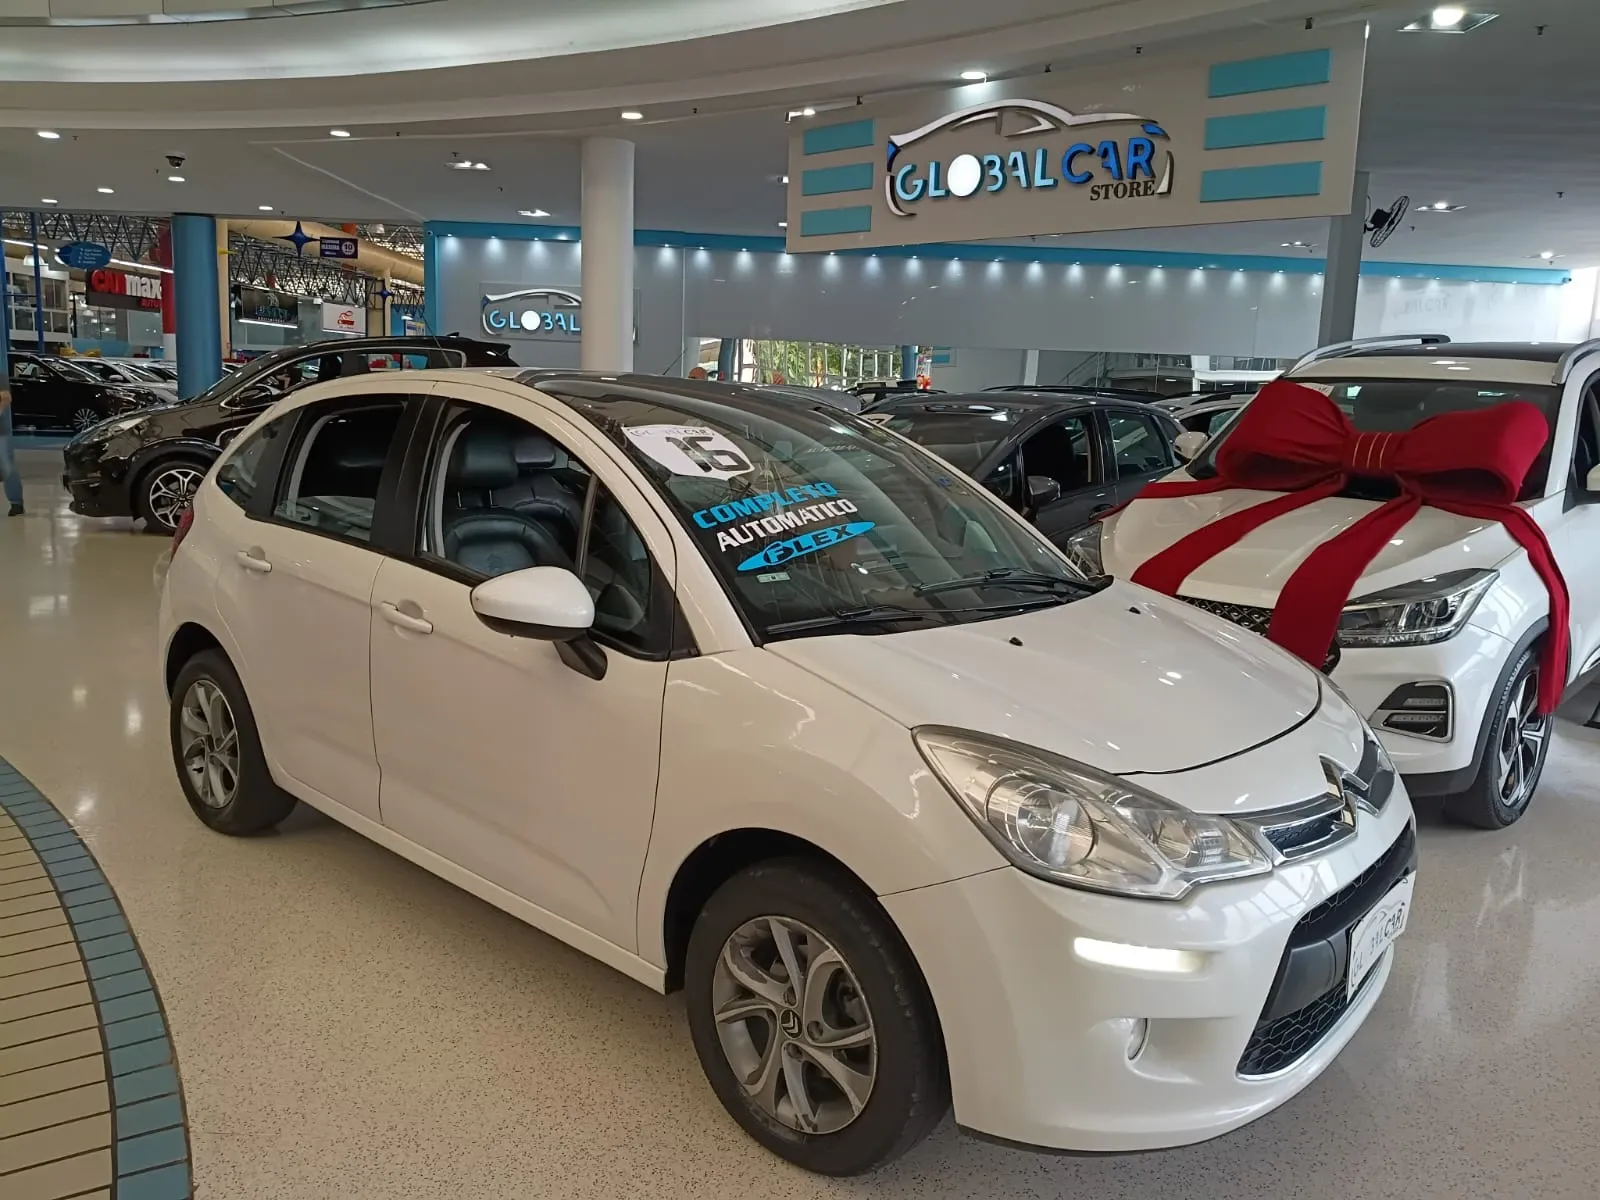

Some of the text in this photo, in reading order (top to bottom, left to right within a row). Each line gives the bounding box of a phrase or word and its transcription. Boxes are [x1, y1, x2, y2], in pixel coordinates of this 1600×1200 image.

[895, 137, 1157, 202] GLOBAL CAR
[1090, 180, 1156, 202] STORE
[489, 310, 581, 332] GLOBAL
[664, 436, 752, 473] 16
[692, 482, 839, 529] COMPLETO
[763, 524, 854, 564] FLEX
